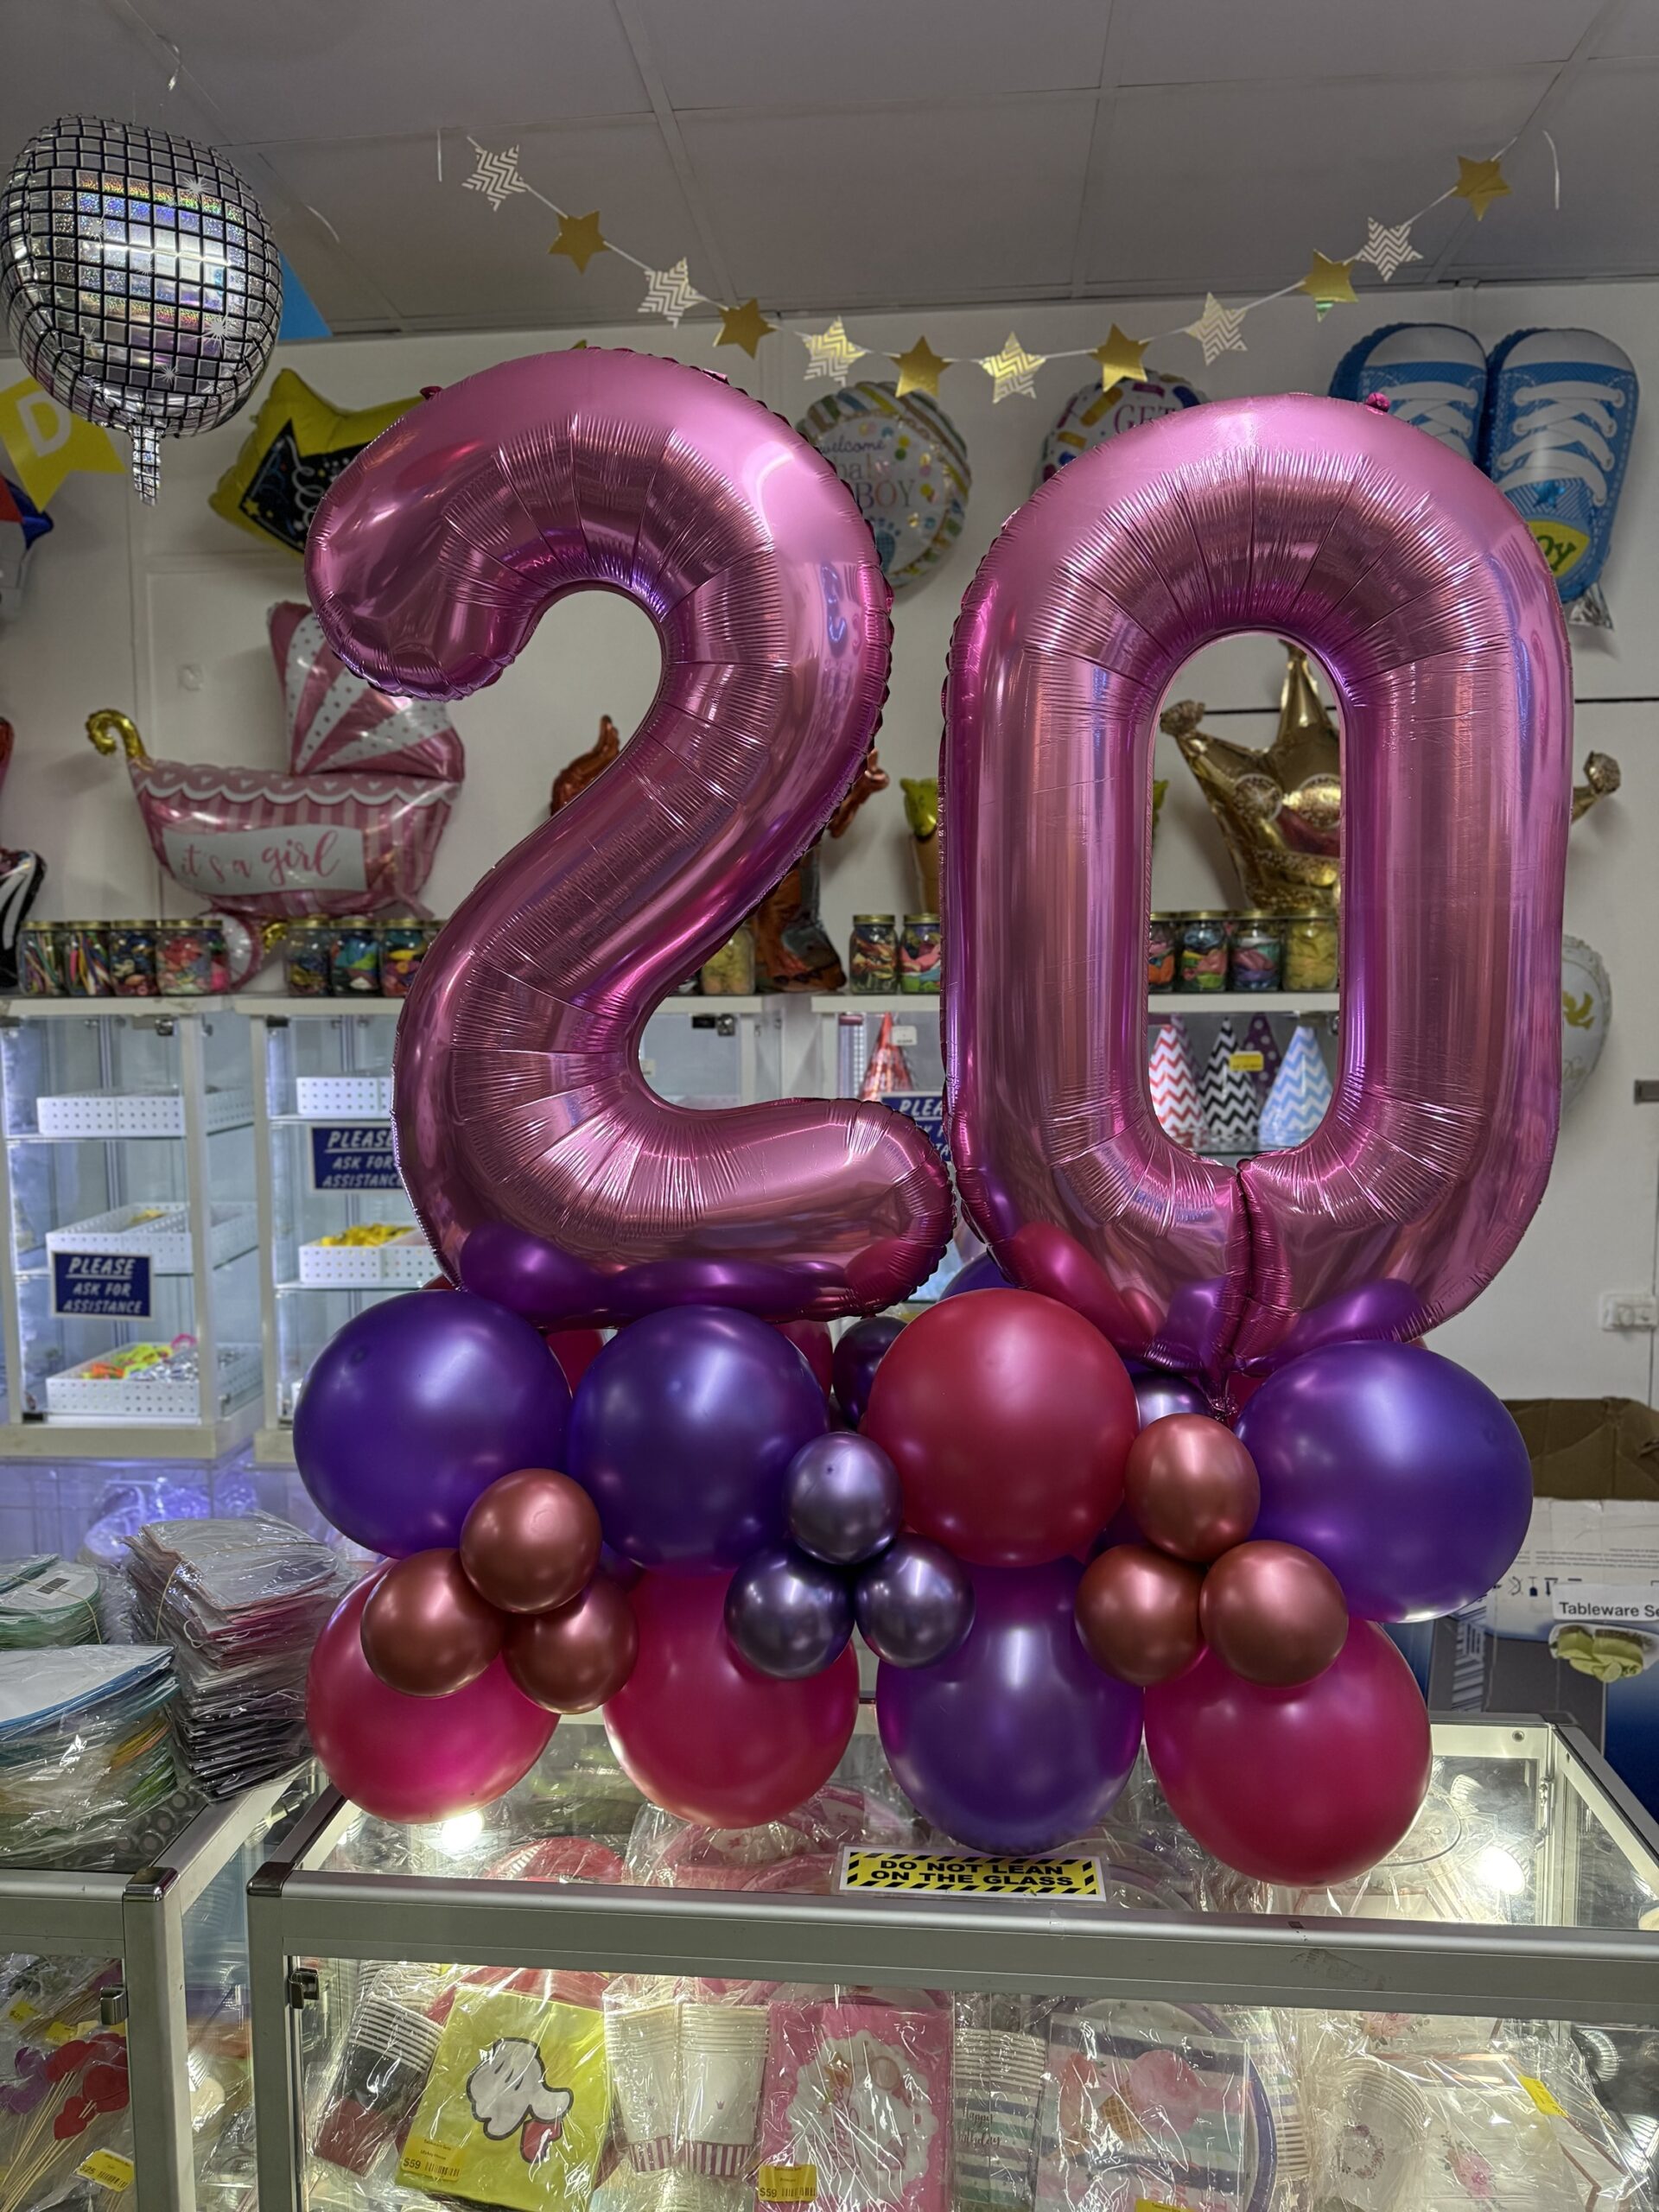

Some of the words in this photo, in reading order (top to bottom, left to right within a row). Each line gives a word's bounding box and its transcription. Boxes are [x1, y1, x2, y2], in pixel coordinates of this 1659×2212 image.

[15, 390, 72, 457] D
[855, 479, 916, 510] BOY
[261, 830, 340, 887] girl
[332, 1156, 362, 1170] ASK
[365, 1155, 394, 1169] FOR
[68, 1256, 137, 1276] PLEASE
[72, 1282, 102, 1296] ASK
[105, 1282, 132, 1297] FOR
[62, 1299, 143, 1314] ASSISTANCE
[1559, 1601, 1639, 1618] Tableware
[880, 1859, 918, 1872] DO
[925, 1862, 983, 1873] NOT
[991, 1864, 1064, 1875] LEAN
[870, 1869, 910, 1881] ON
[918, 1872, 974, 1884] THE
[982, 1874, 1074, 1886] GLASS
